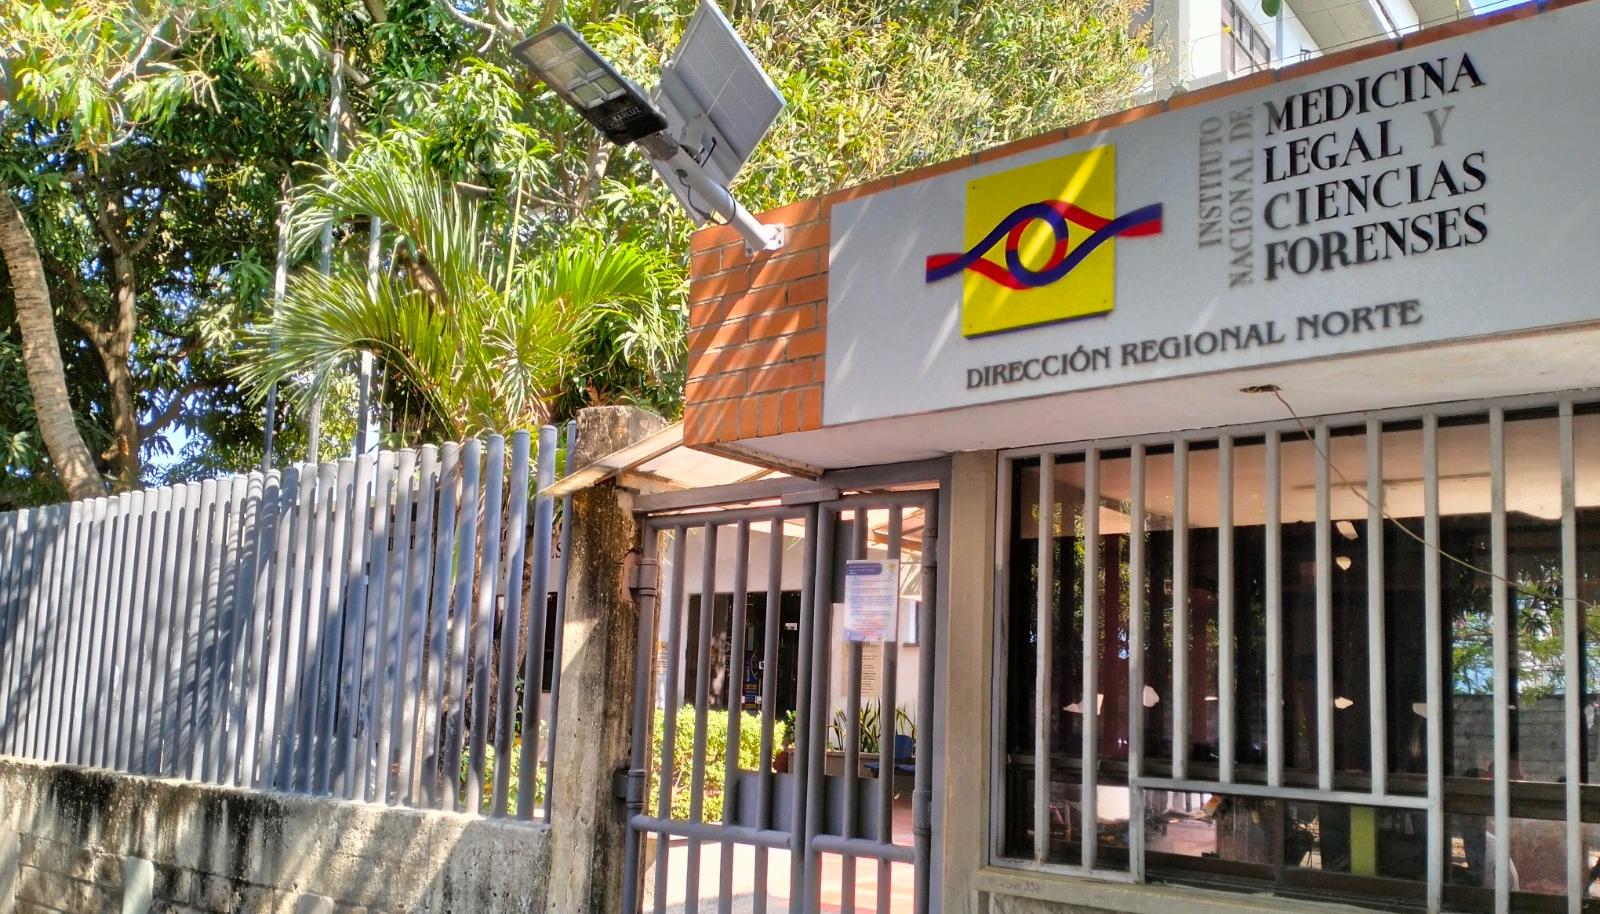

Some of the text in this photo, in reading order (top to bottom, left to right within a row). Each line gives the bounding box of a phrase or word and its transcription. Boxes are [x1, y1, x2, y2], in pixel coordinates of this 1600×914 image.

[1262, 52, 1487, 136] MEDICINA
[1198, 116, 1224, 250] INSTITUTO
[1262, 105, 1456, 184] LEGAL Y
[1228, 106, 1254, 289] NACIONAL DE
[1262, 150, 1488, 232] CIENCIAS
[1263, 202, 1489, 282] FORENSES
[966, 299, 1424, 390] DIRECCIÓN REGIONAL NORTE
